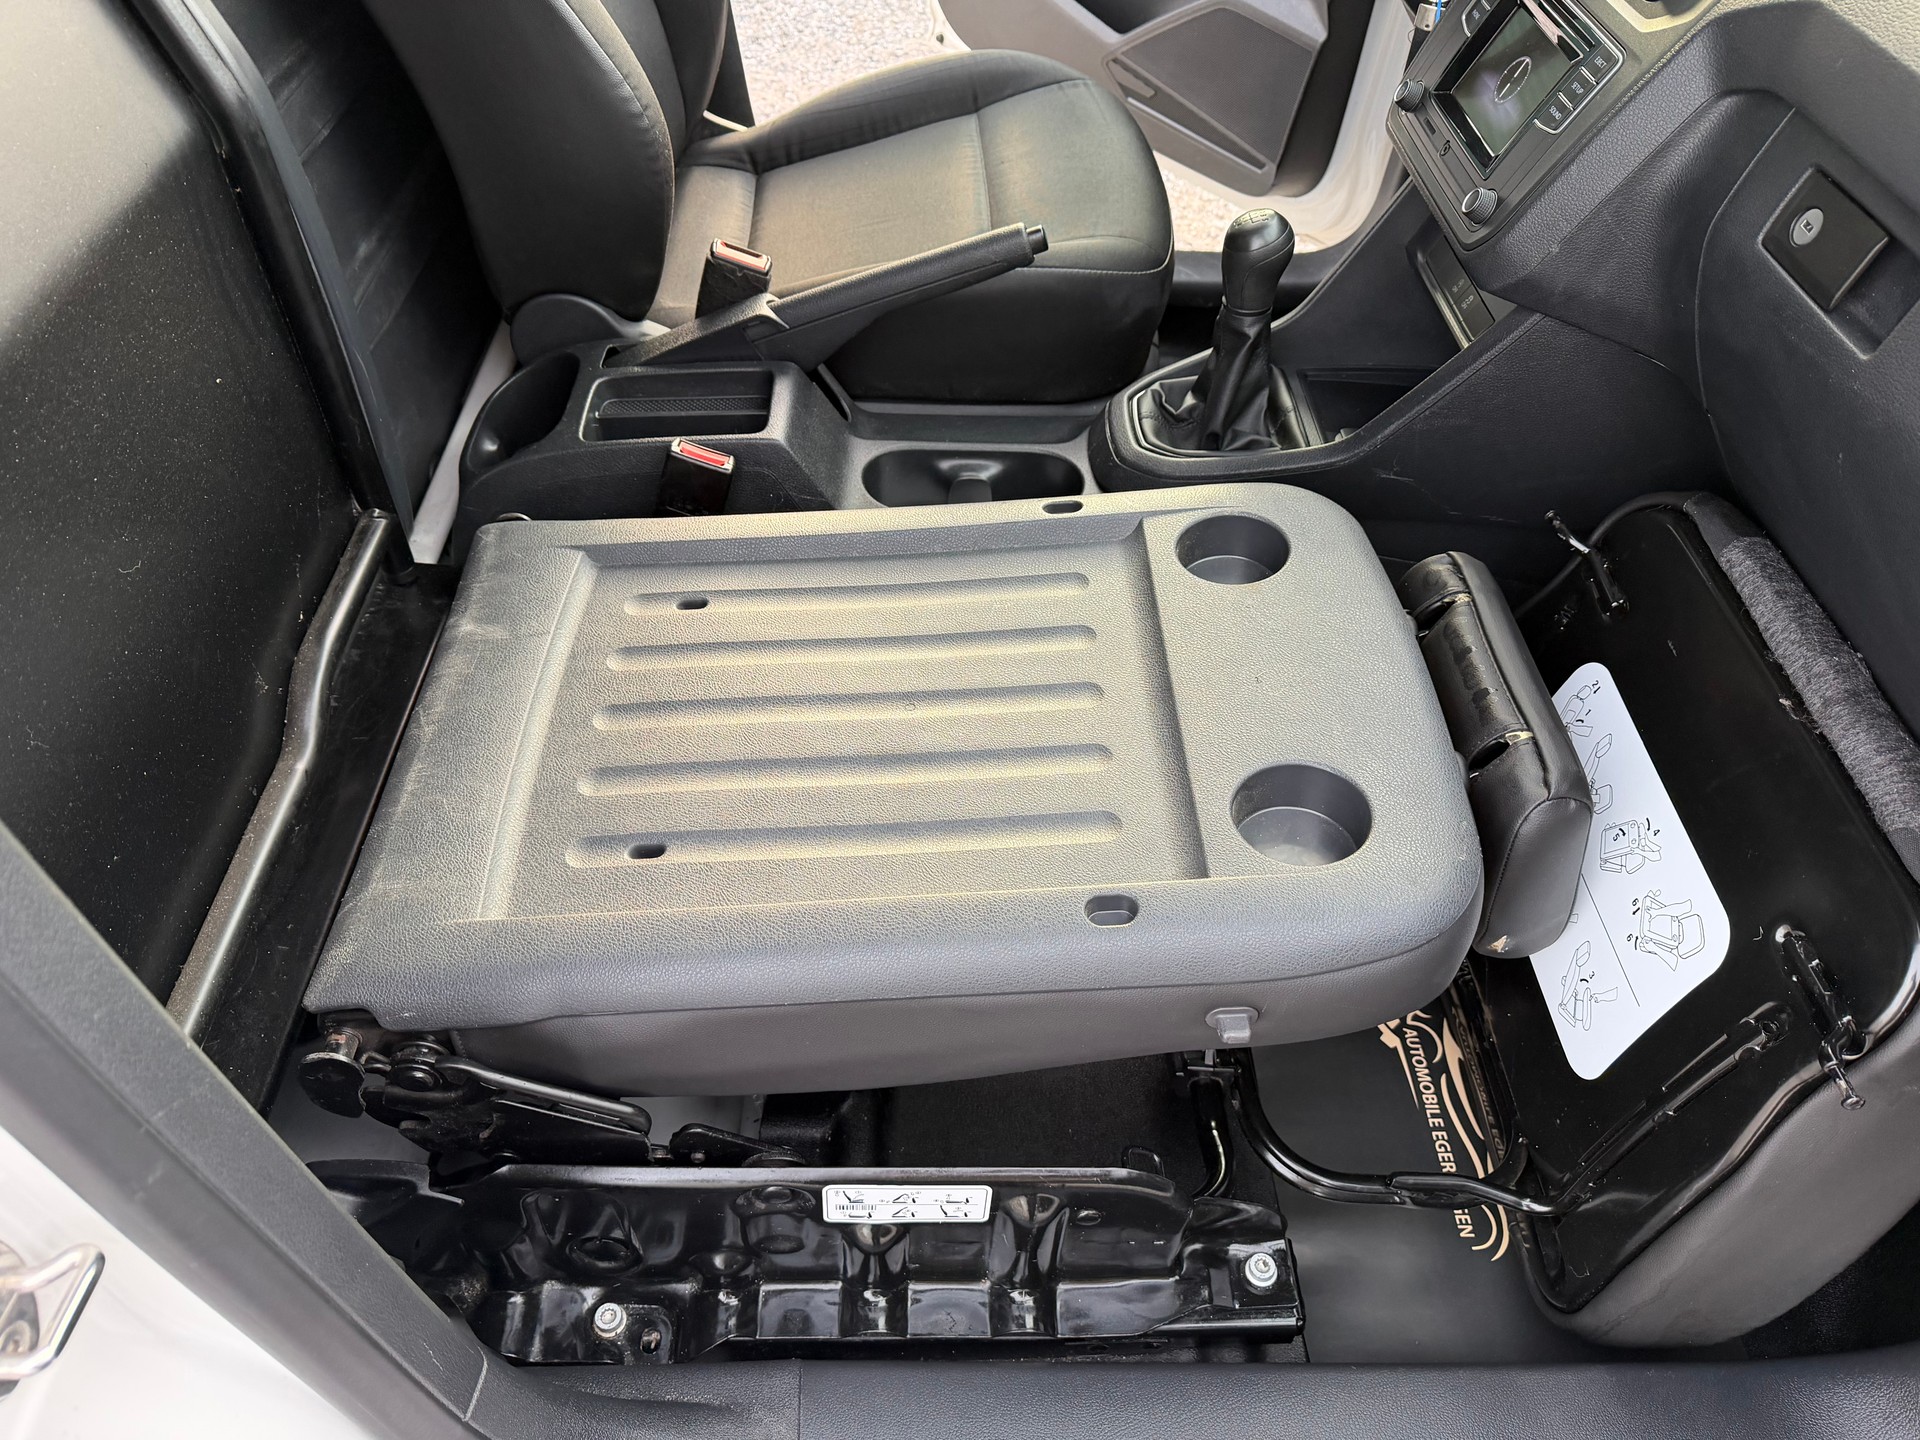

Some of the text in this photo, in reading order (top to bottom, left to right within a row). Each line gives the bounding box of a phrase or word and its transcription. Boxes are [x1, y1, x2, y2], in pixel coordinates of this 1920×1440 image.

[1594, 56, 1607, 69] EJECT
[1571, 81, 1584, 94] SETUP
[1549, 105, 1562, 120] SOUND
[1612, 832, 1620, 842] 5
[1402, 1027, 1445, 1128] AUTOMOBILE
